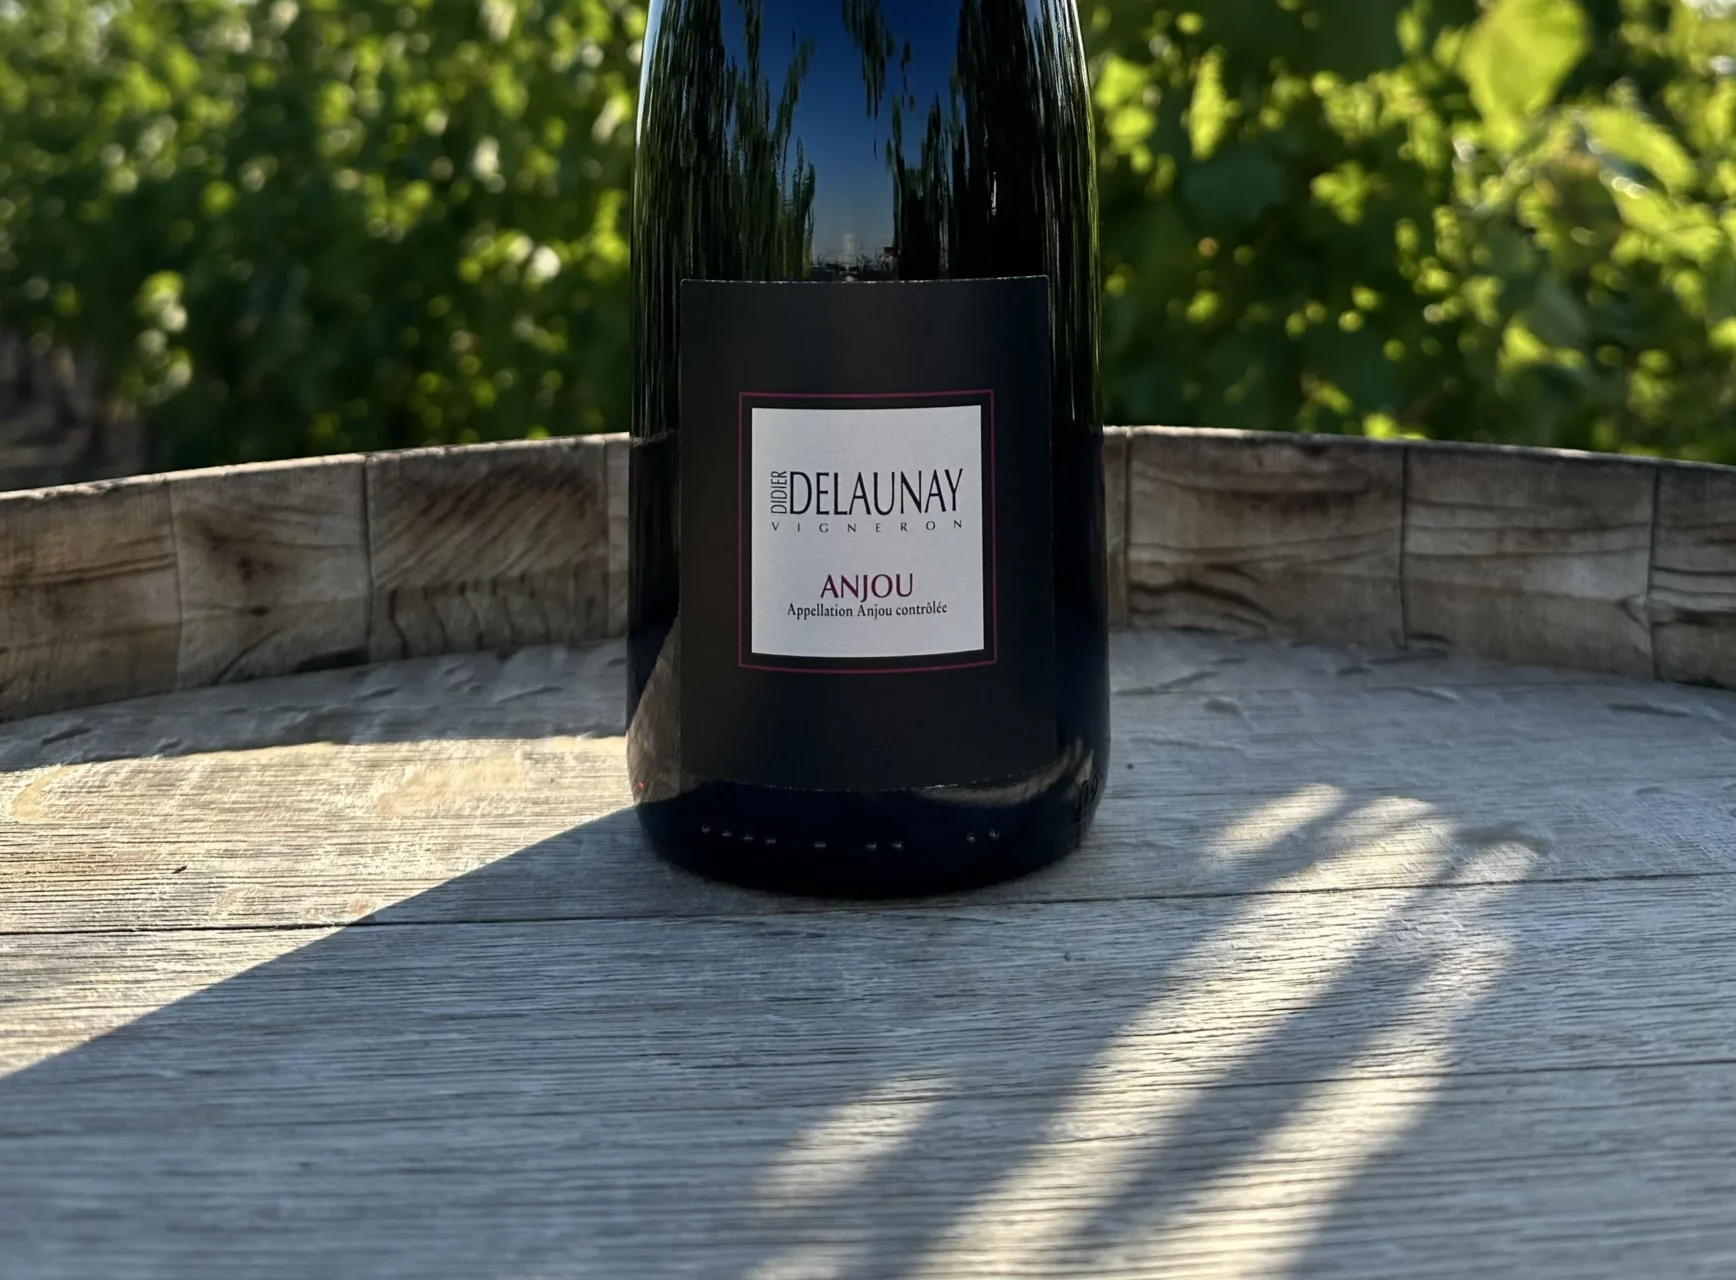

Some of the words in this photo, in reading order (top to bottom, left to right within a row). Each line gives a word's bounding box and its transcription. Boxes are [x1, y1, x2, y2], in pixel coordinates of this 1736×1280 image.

[770, 470, 788, 515] DIDIER
[789, 468, 963, 516] DELAUNAY
[771, 519, 963, 533] VIGNERON
[820, 573, 913, 603] ANJOU
[787, 603, 853, 620] Appellation
[857, 604, 893, 620] Anjou
[896, 601, 948, 616] contrôlée
